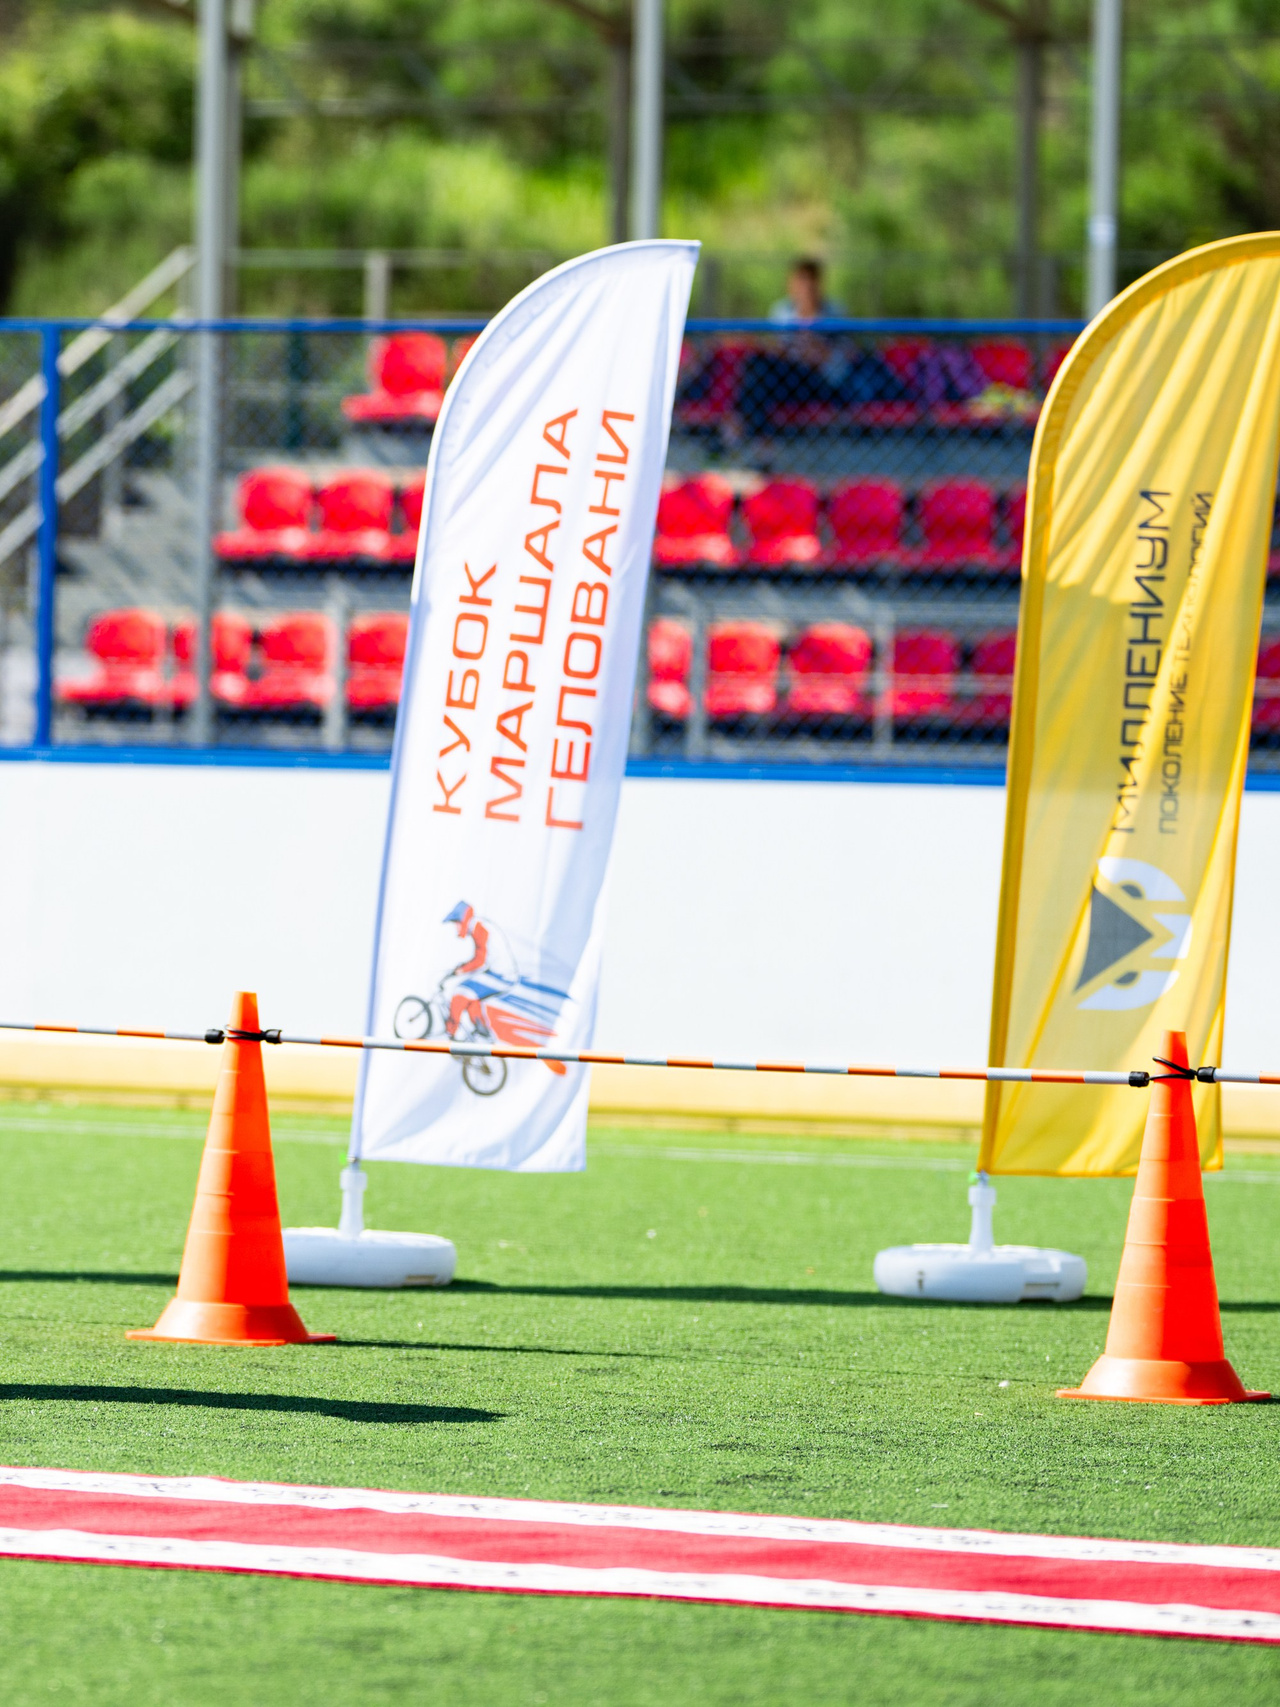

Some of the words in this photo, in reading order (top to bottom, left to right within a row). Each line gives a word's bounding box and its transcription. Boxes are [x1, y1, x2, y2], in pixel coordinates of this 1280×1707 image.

[432, 560, 497, 816] КУБОК
[485, 408, 579, 824] МАРШАЛА
[544, 410, 635, 831] ГЕЛОВАНИ
[1111, 490, 1172, 834] МИЛЛЕНИУМ
